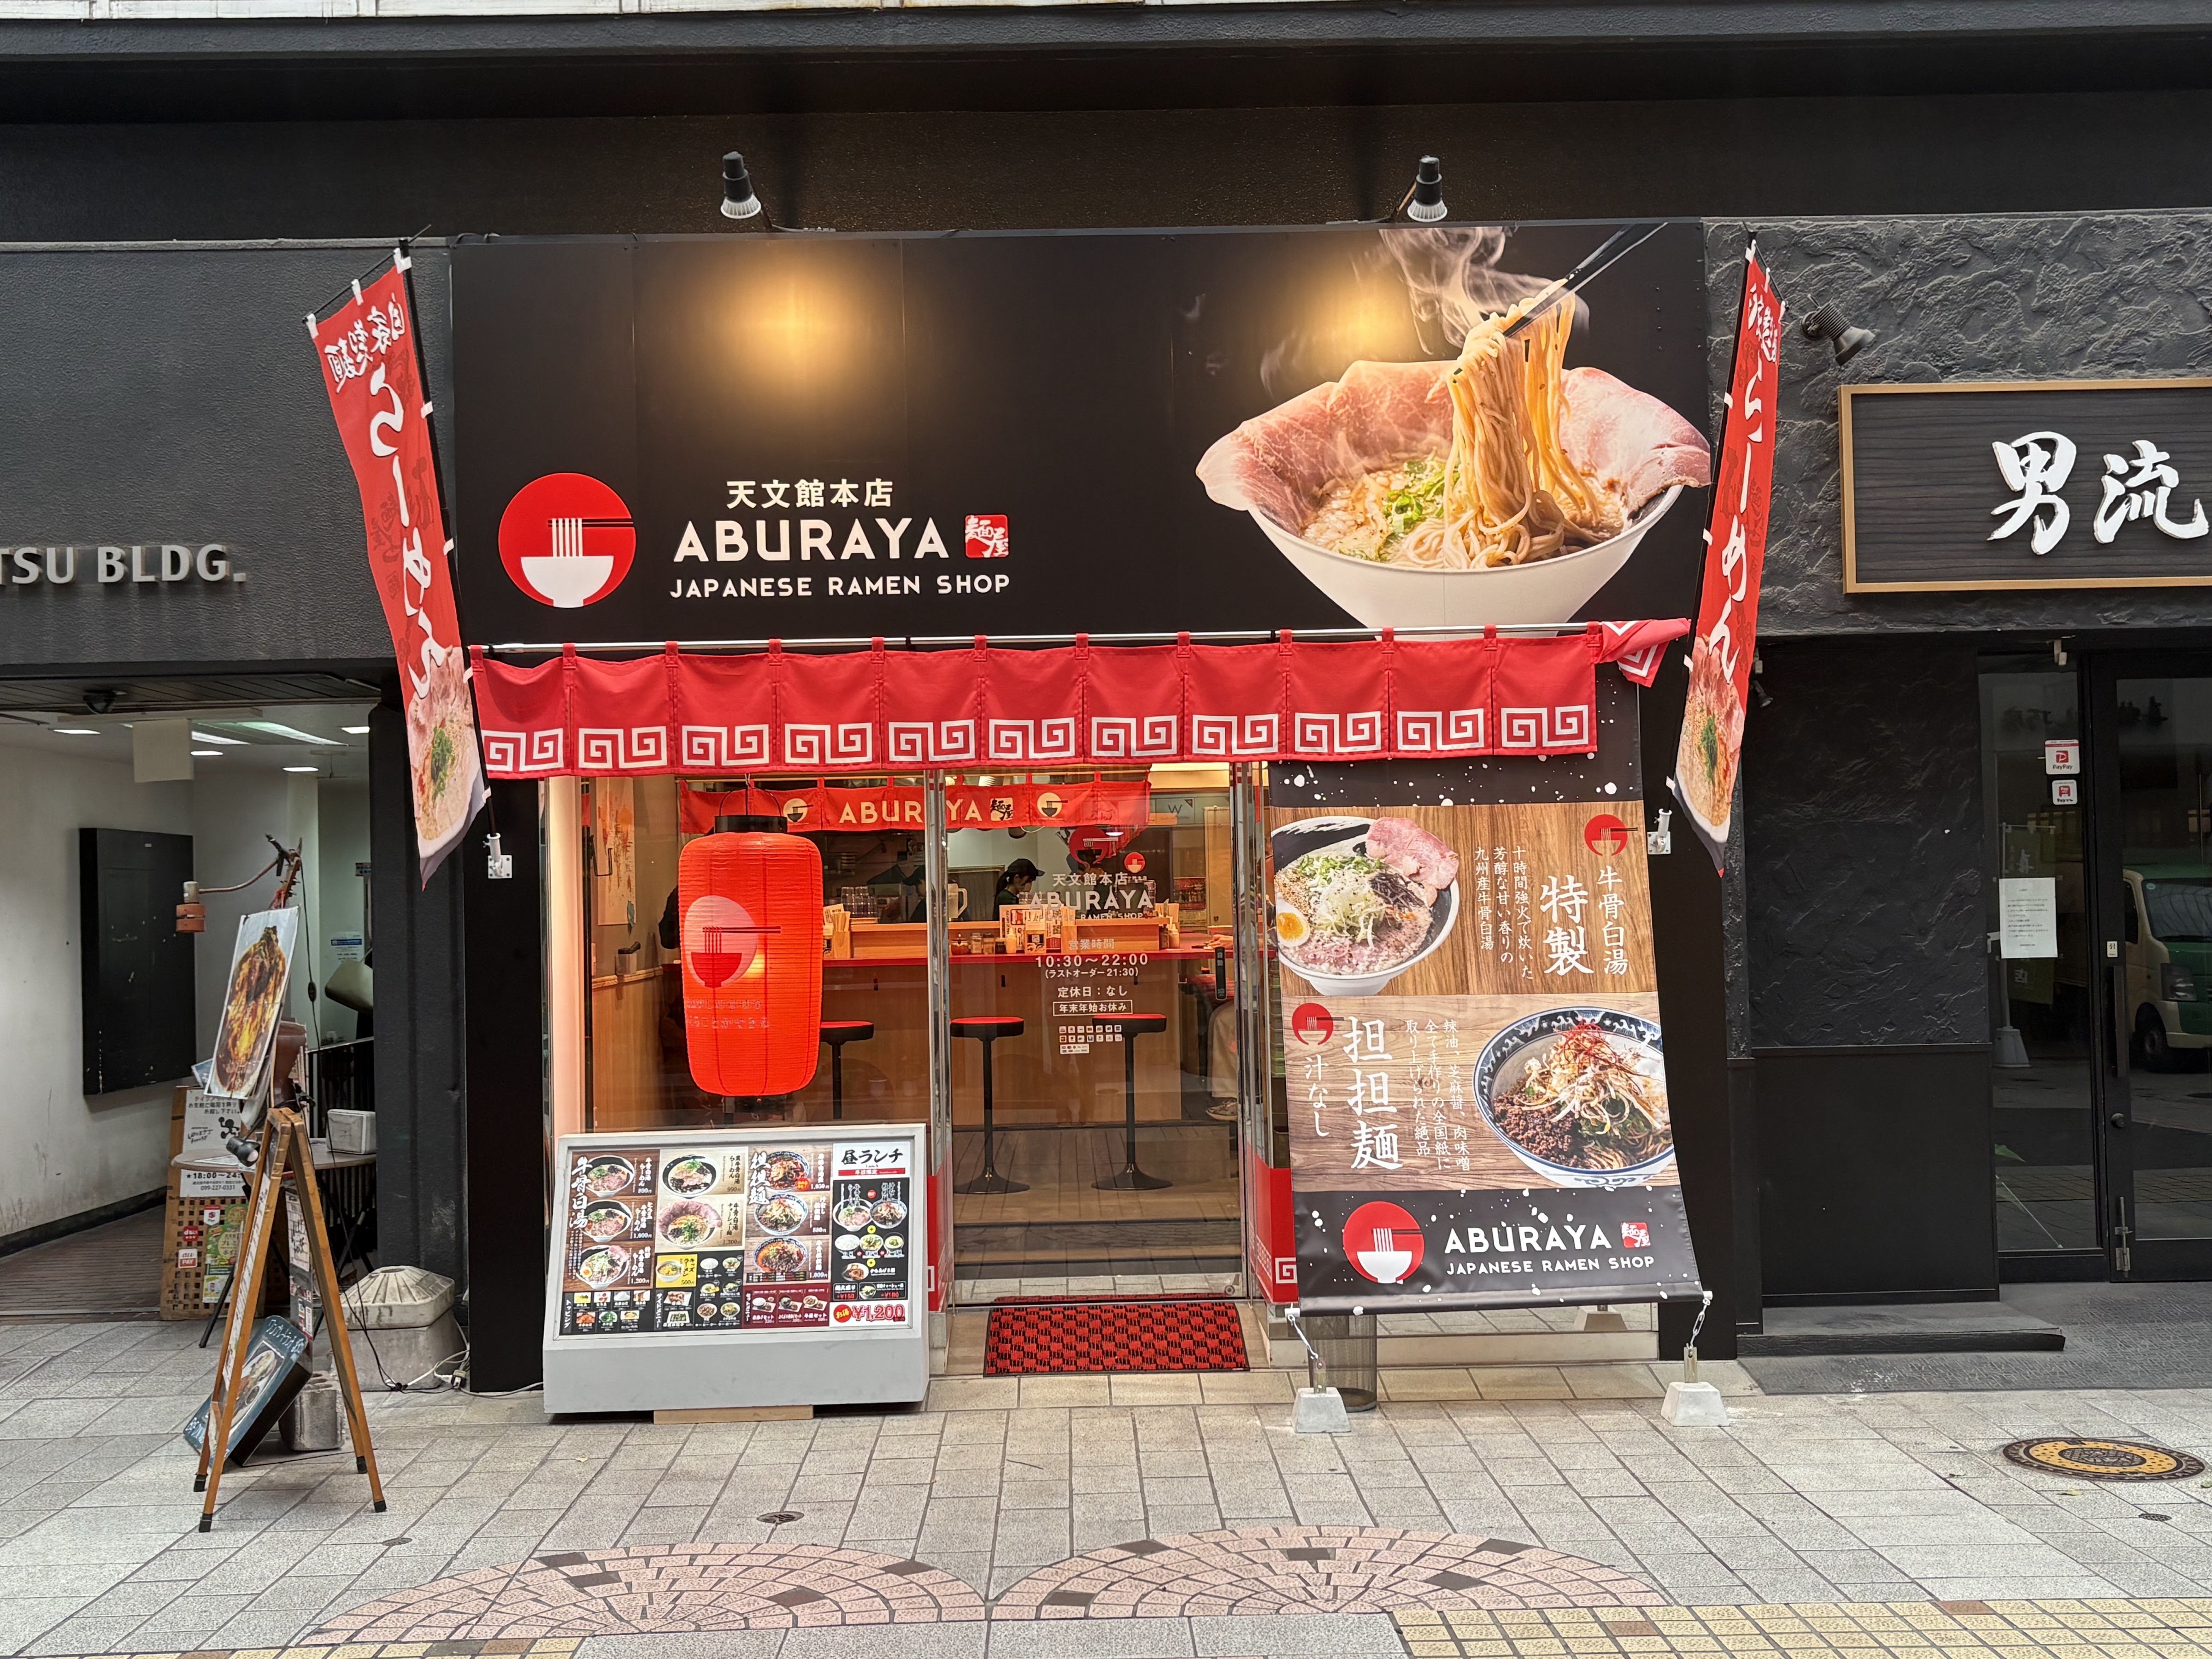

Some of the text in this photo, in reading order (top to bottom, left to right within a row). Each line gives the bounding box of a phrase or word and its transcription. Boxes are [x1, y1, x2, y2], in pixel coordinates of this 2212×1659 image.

[726, 478, 894, 509] 天文館本店
[1986, 430, 2210, 555] 男流
[673, 517, 950, 562] ABURAYA
[98, 544, 247, 582] BLDG.
[670, 574, 1010, 599] JAPANESE RAMEN SHOP
[839, 799, 983, 824] ABURYA
[1029, 889, 1154, 910] ABURAYA
[1052, 871, 1129, 887] 天文館本店
[1474, 847, 1494, 951] 九州産牛骨白湯
[1493, 846, 1513, 964] 芳醇な甘い香りの
[1512, 845, 1534, 980] 十時間強火で炊いた
[1540, 874, 1594, 976] 特製
[1596, 865, 1629, 976] 牛骨白湯
[1068, 938, 1115, 950] 営業時間
[1059, 1003, 1127, 1013] 年末年始お休み
[1304, 1053, 1330, 1137] 汁なし
[1342, 1016, 1403, 1170] 担担麺
[1405, 1019, 1430, 1156] 取り上げられた絶品
[1424, 1018, 1451, 1171] 全て手作りの全国紙に
[841, 1148, 903, 1165] 昼ランチ
[569, 1156, 593, 1229] 牛骨白湯
[1444, 1224, 1612, 1254] ABURAYA
[1446, 1255, 1655, 1276] JAPANESE RAMEN SHOP
[564, 1299, 572, 1329] トッピング
